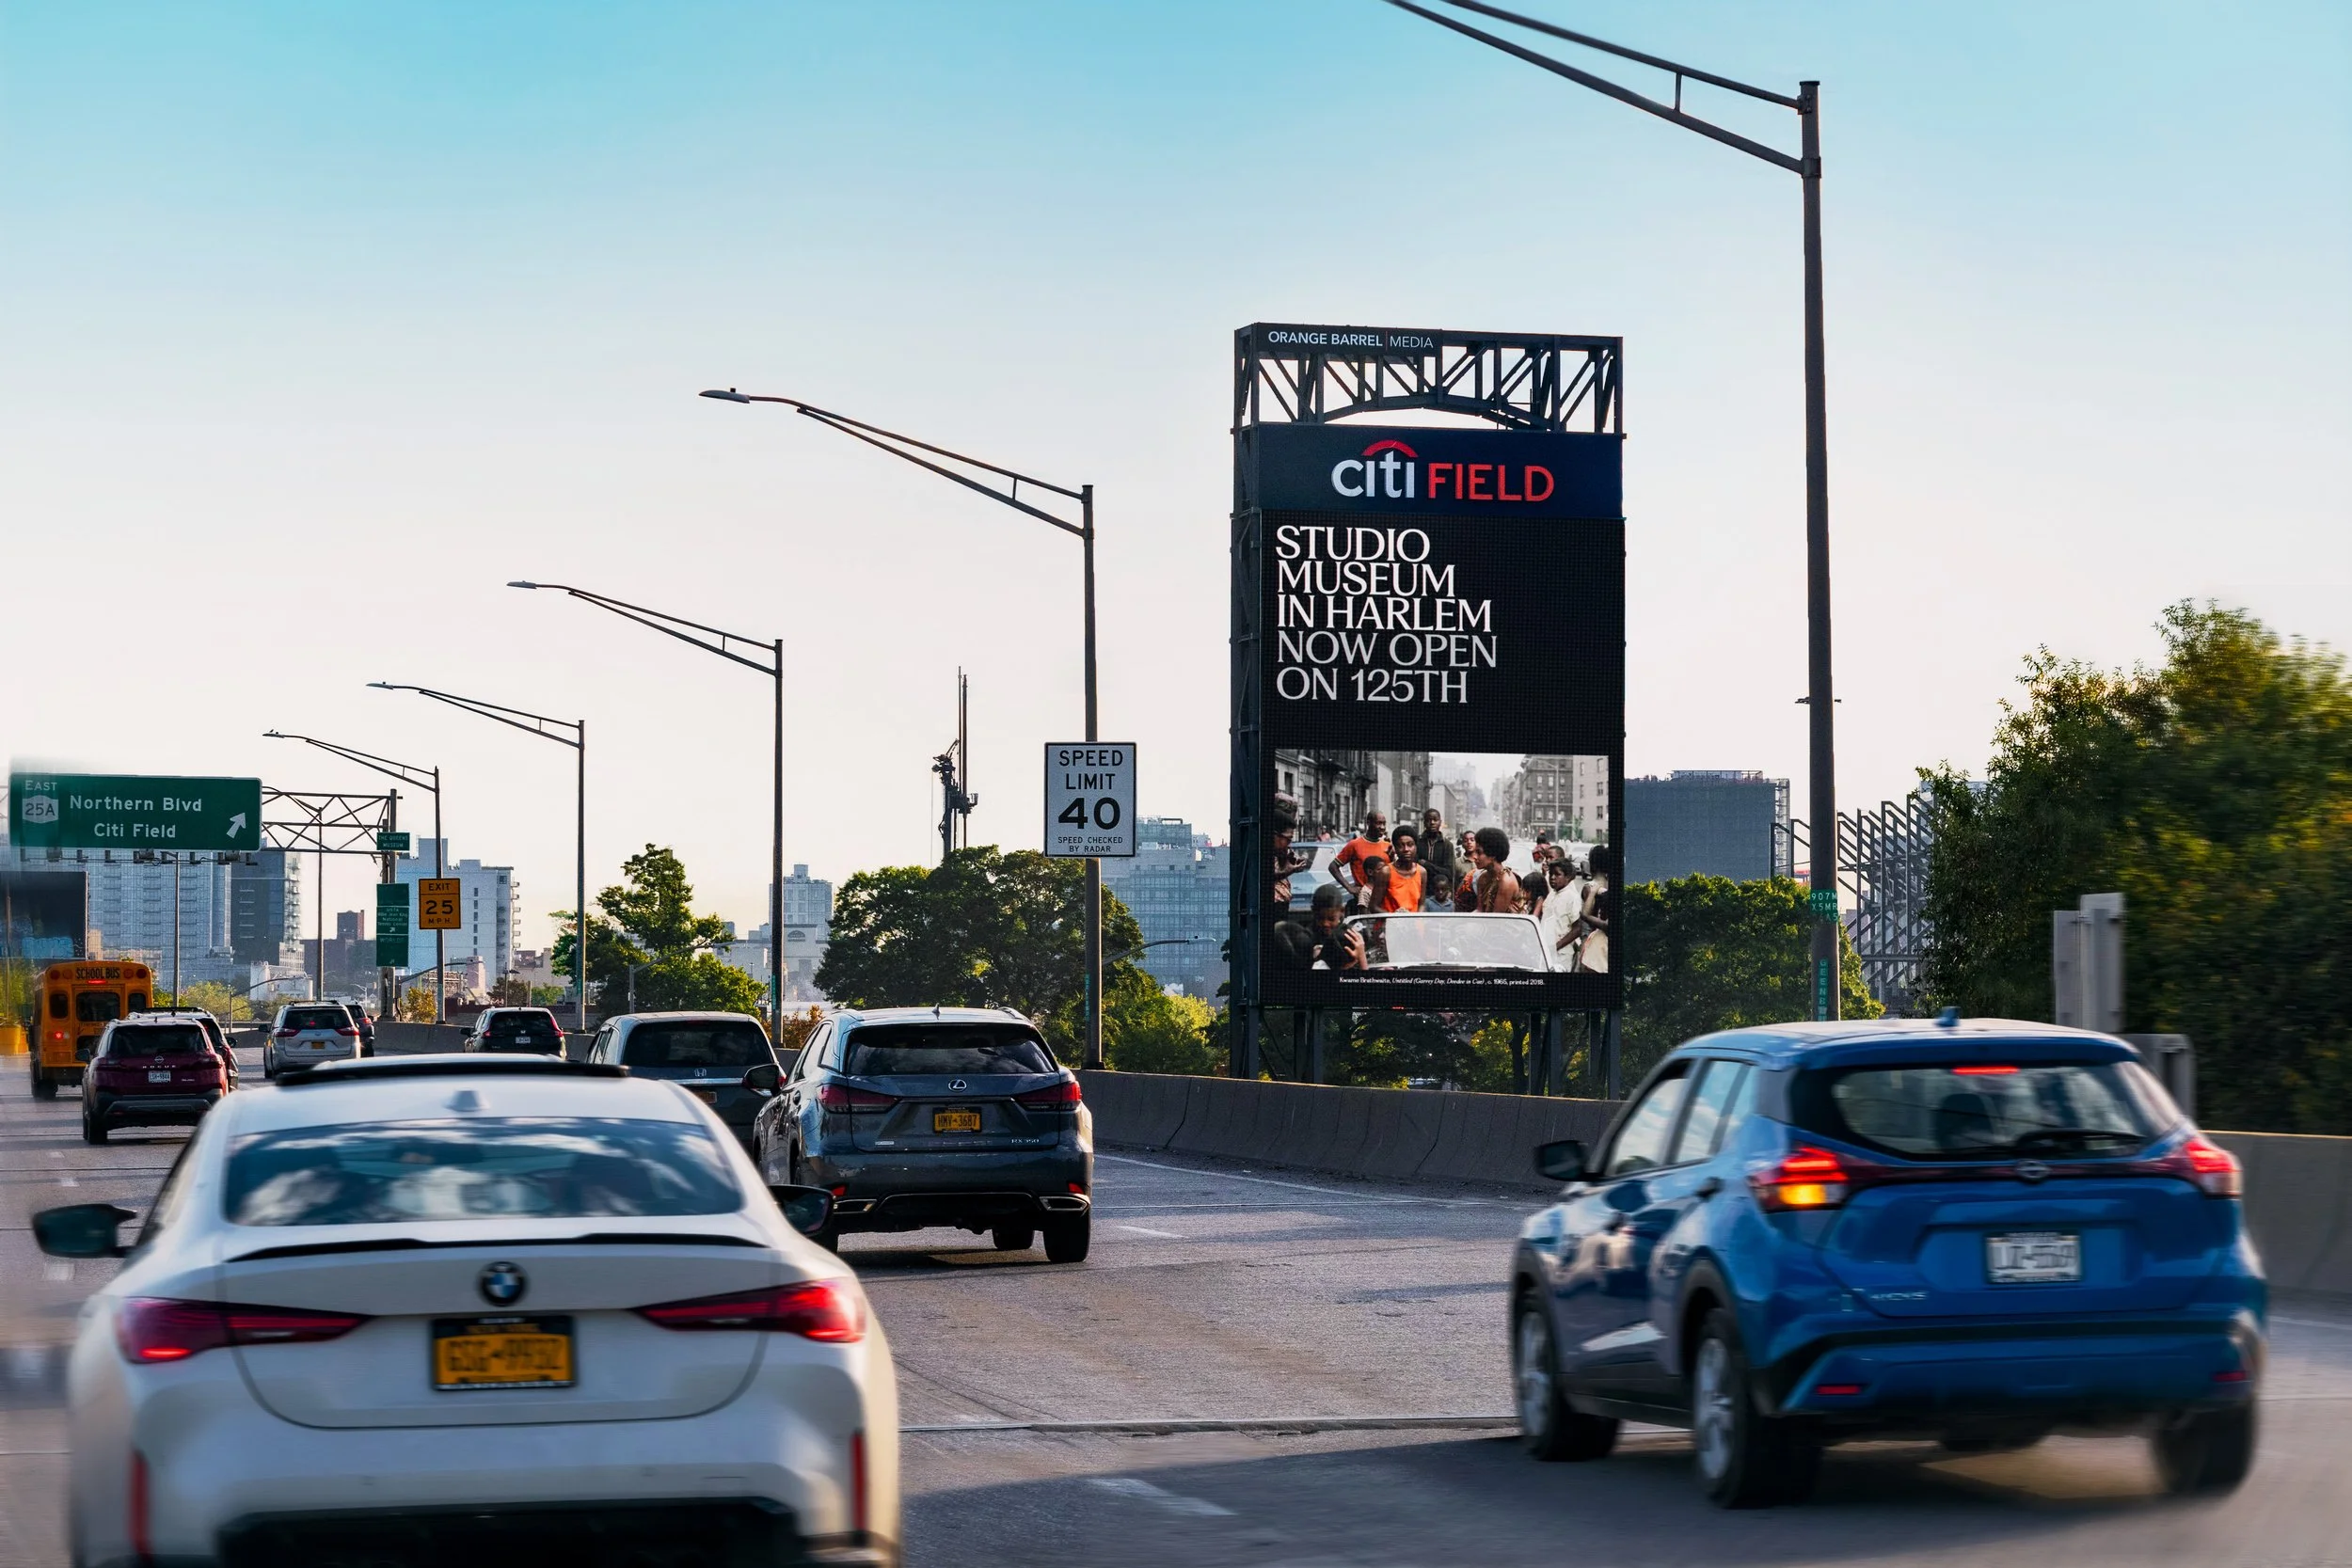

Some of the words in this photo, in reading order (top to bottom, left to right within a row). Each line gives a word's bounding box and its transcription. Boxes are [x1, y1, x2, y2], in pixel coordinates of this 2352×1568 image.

[1267, 330, 1328, 345] ORANGE
[1330, 333, 1384, 348] BARREL
[1390, 336, 1435, 349] MEDIA
[1331, 450, 1416, 499] citi
[1428, 463, 1554, 502] FIELD
[1275, 524, 1431, 562] STUDIO
[1277, 561, 1455, 597] MUSEUM
[1277, 594, 1315, 628] IN
[1326, 595, 1493, 632] HARLEM
[1277, 630, 1379, 665] NOW
[1389, 633, 1498, 668] OPEN
[1276, 666, 1338, 701] ON
[1350, 668, 1469, 704] 125TH
[1058, 750, 1123, 767] SPEED
[25, 780, 57, 791] EAST
[1065, 773, 1116, 790] LIMIT
[25, 802, 56, 816] 25A
[70, 795, 153, 811] Northern
[163, 797, 202, 812] Blvd
[1057, 797, 1120, 830] 40
[94, 822, 124, 837] Citi
[133, 824, 176, 838] Field
[1069, 845, 1080, 853] BY
[1084, 845, 1111, 853] RADAR
[428, 882, 452, 892] EXIT
[425, 899, 453, 915] 25
[76, 967, 104, 979] SCHOOL
[105, 967, 120, 979] BUS
[1509, 978, 1529, 987] printed
